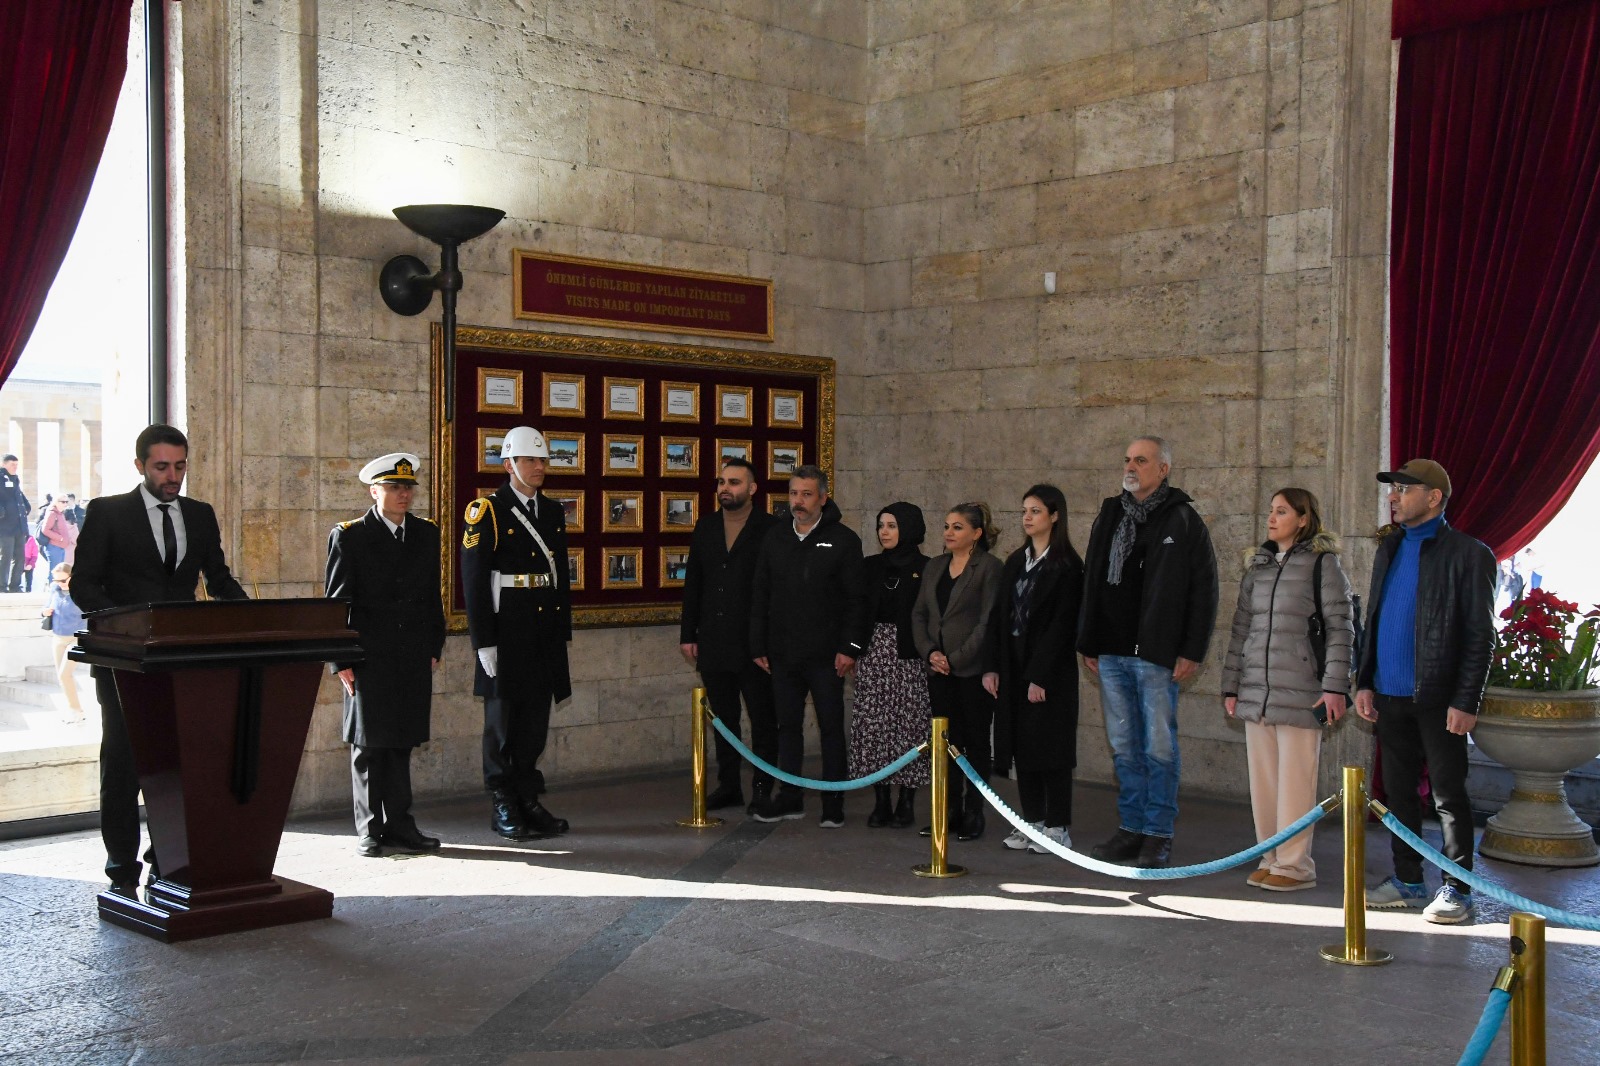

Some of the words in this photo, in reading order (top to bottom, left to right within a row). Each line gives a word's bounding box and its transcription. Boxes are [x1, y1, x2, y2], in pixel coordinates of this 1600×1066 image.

[546, 269, 586, 287] ÖNEMLİ
[589, 275, 642, 294] GÜNLERDE
[645, 283, 687, 299] YAPILAN
[689, 286, 746, 304] ZİYARETLER
[565, 294, 600, 309] VISITS
[602, 298, 631, 312] MADE
[633, 302, 647, 313] ON
[649, 303, 705, 319] IMPORTANT
[707, 309, 731, 321] DAYS
